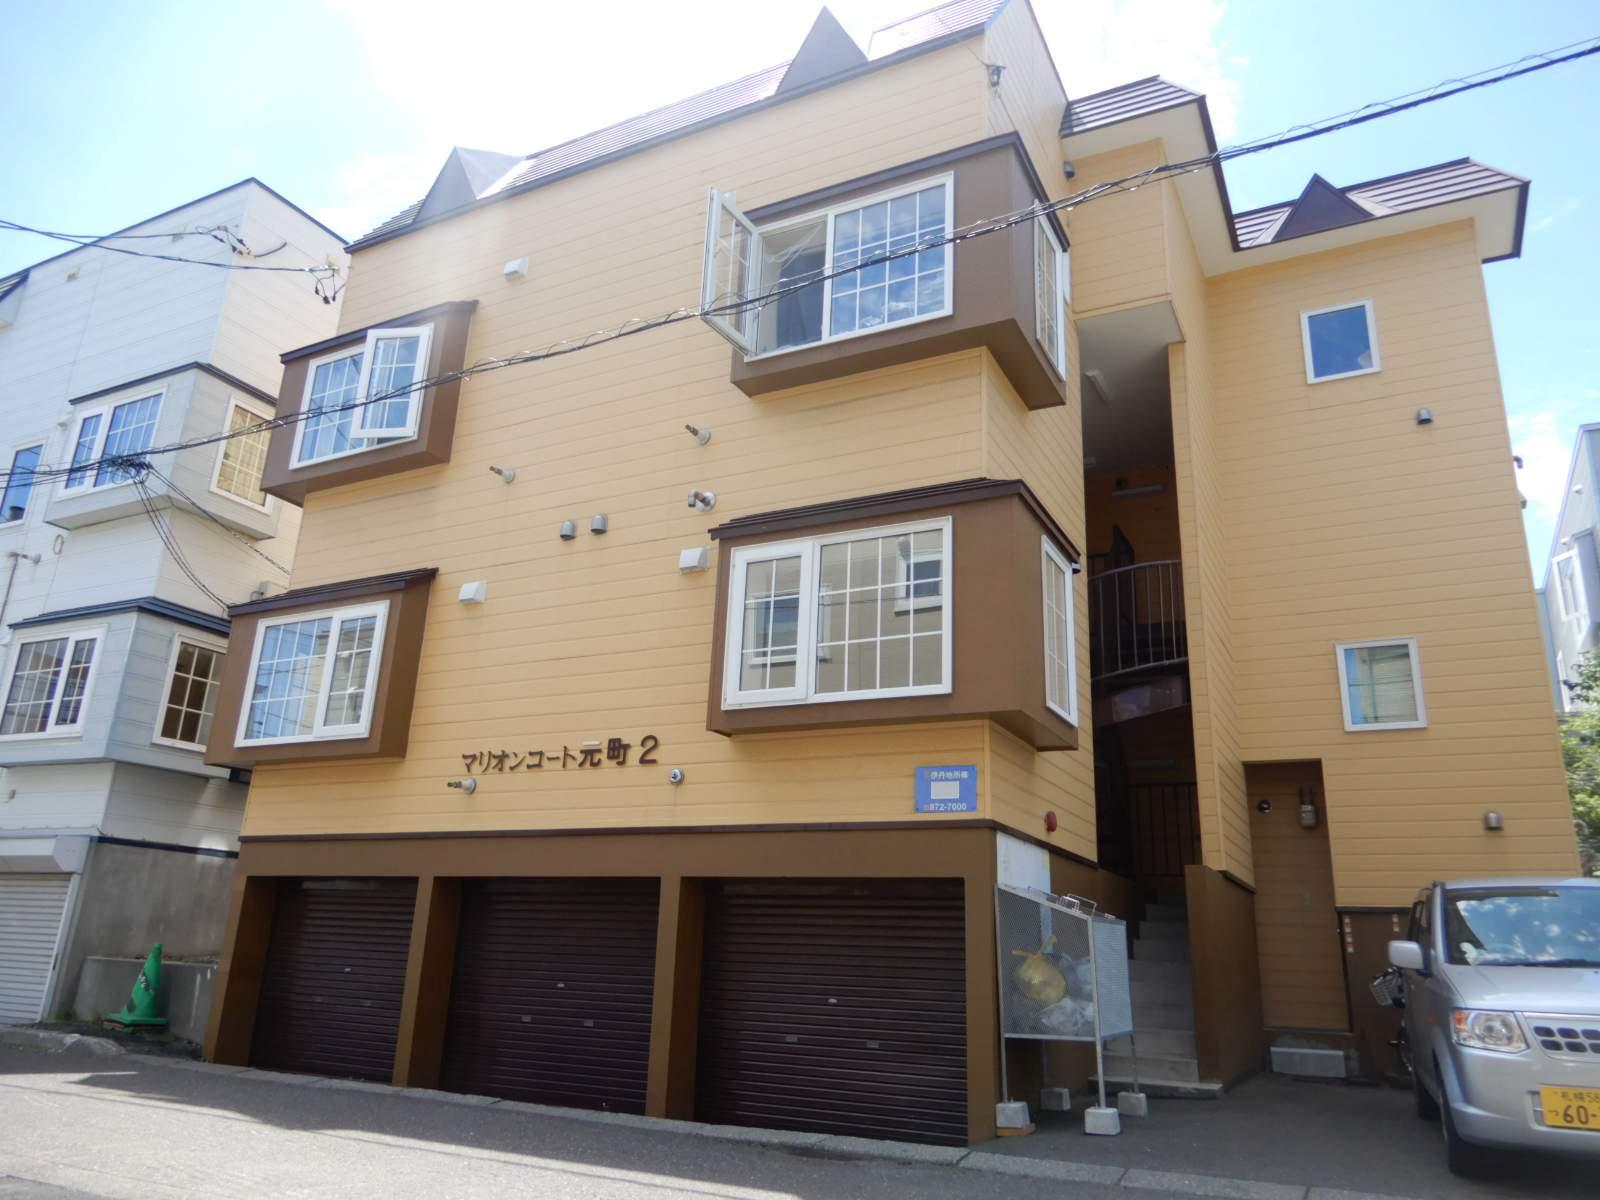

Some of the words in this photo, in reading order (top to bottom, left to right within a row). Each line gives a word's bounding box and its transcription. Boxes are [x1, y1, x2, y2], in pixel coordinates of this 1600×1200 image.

[461, 734, 659, 773] マリオンコート元町2
